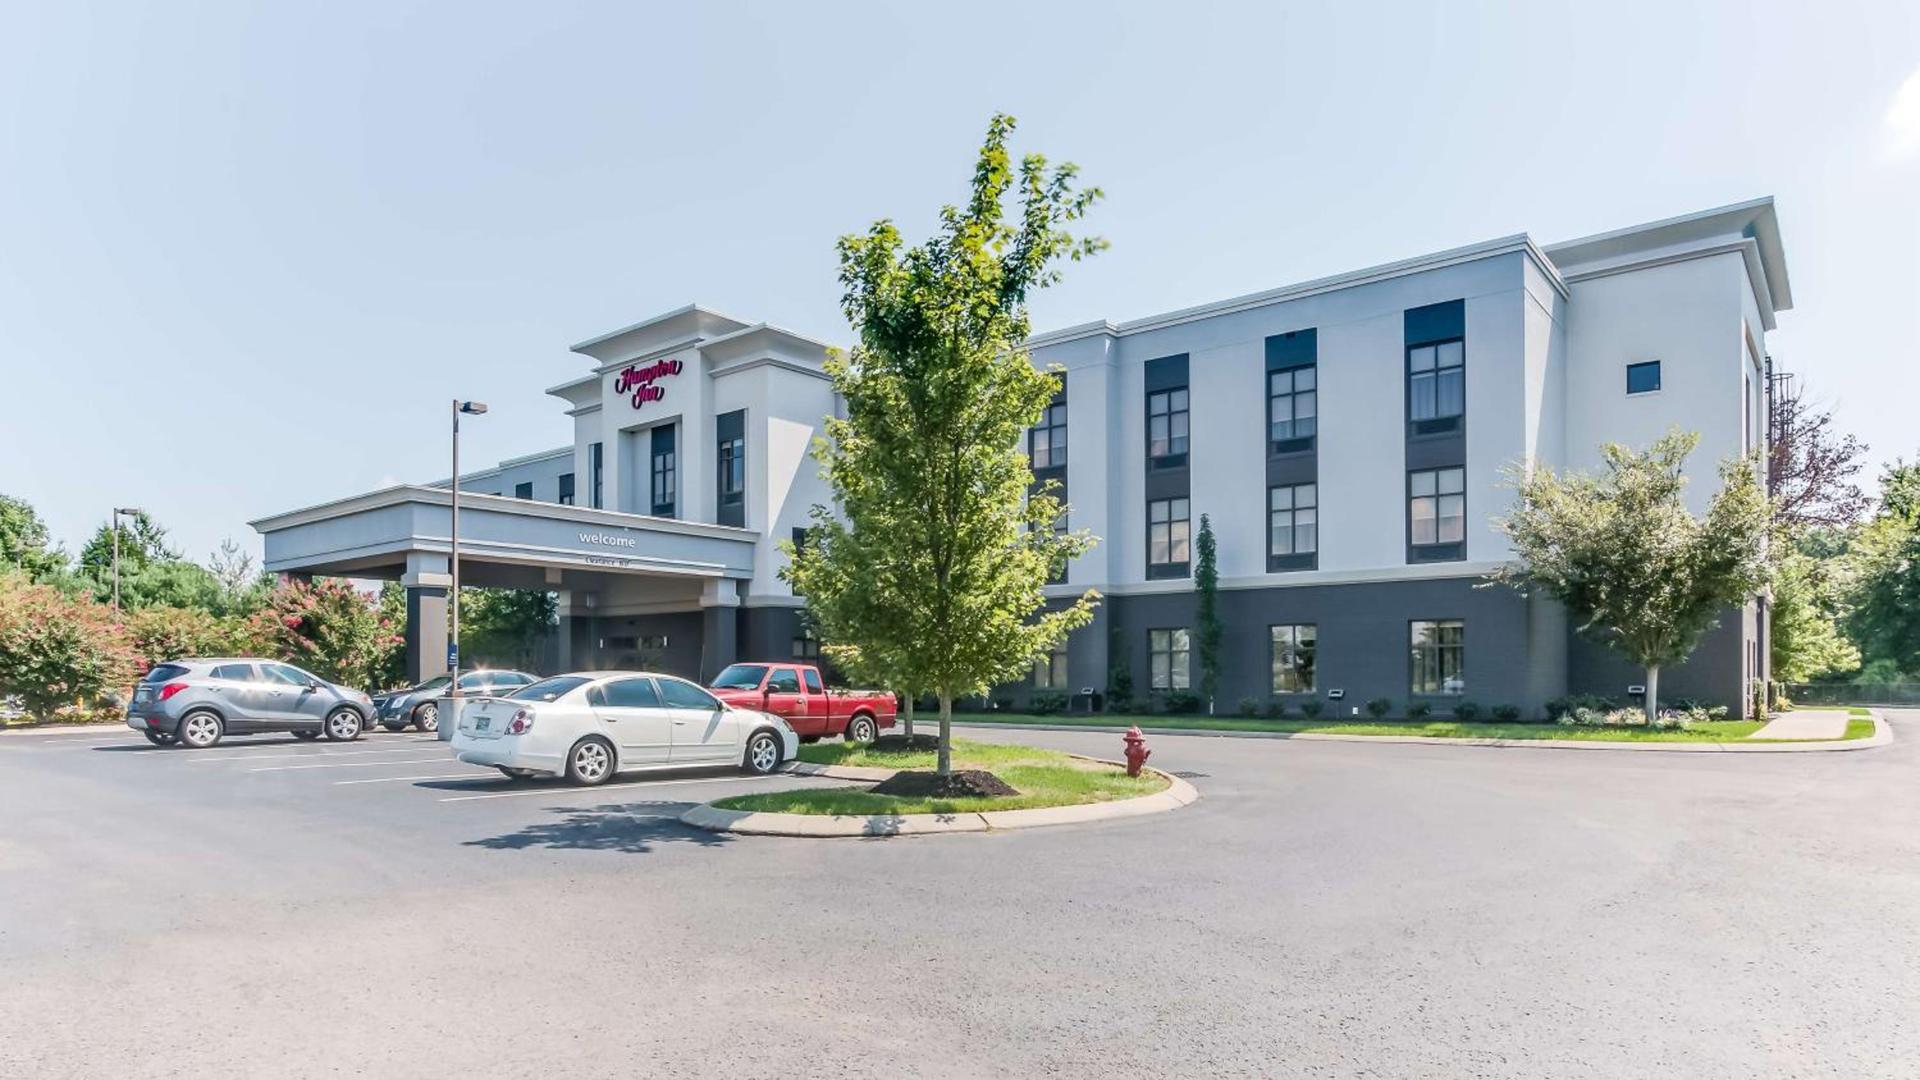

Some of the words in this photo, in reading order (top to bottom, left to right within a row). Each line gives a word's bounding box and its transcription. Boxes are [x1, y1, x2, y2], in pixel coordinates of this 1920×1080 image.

[615, 359, 682, 394] Hampton
[632, 383, 665, 409] Inn
[578, 532, 636, 548] welcome
